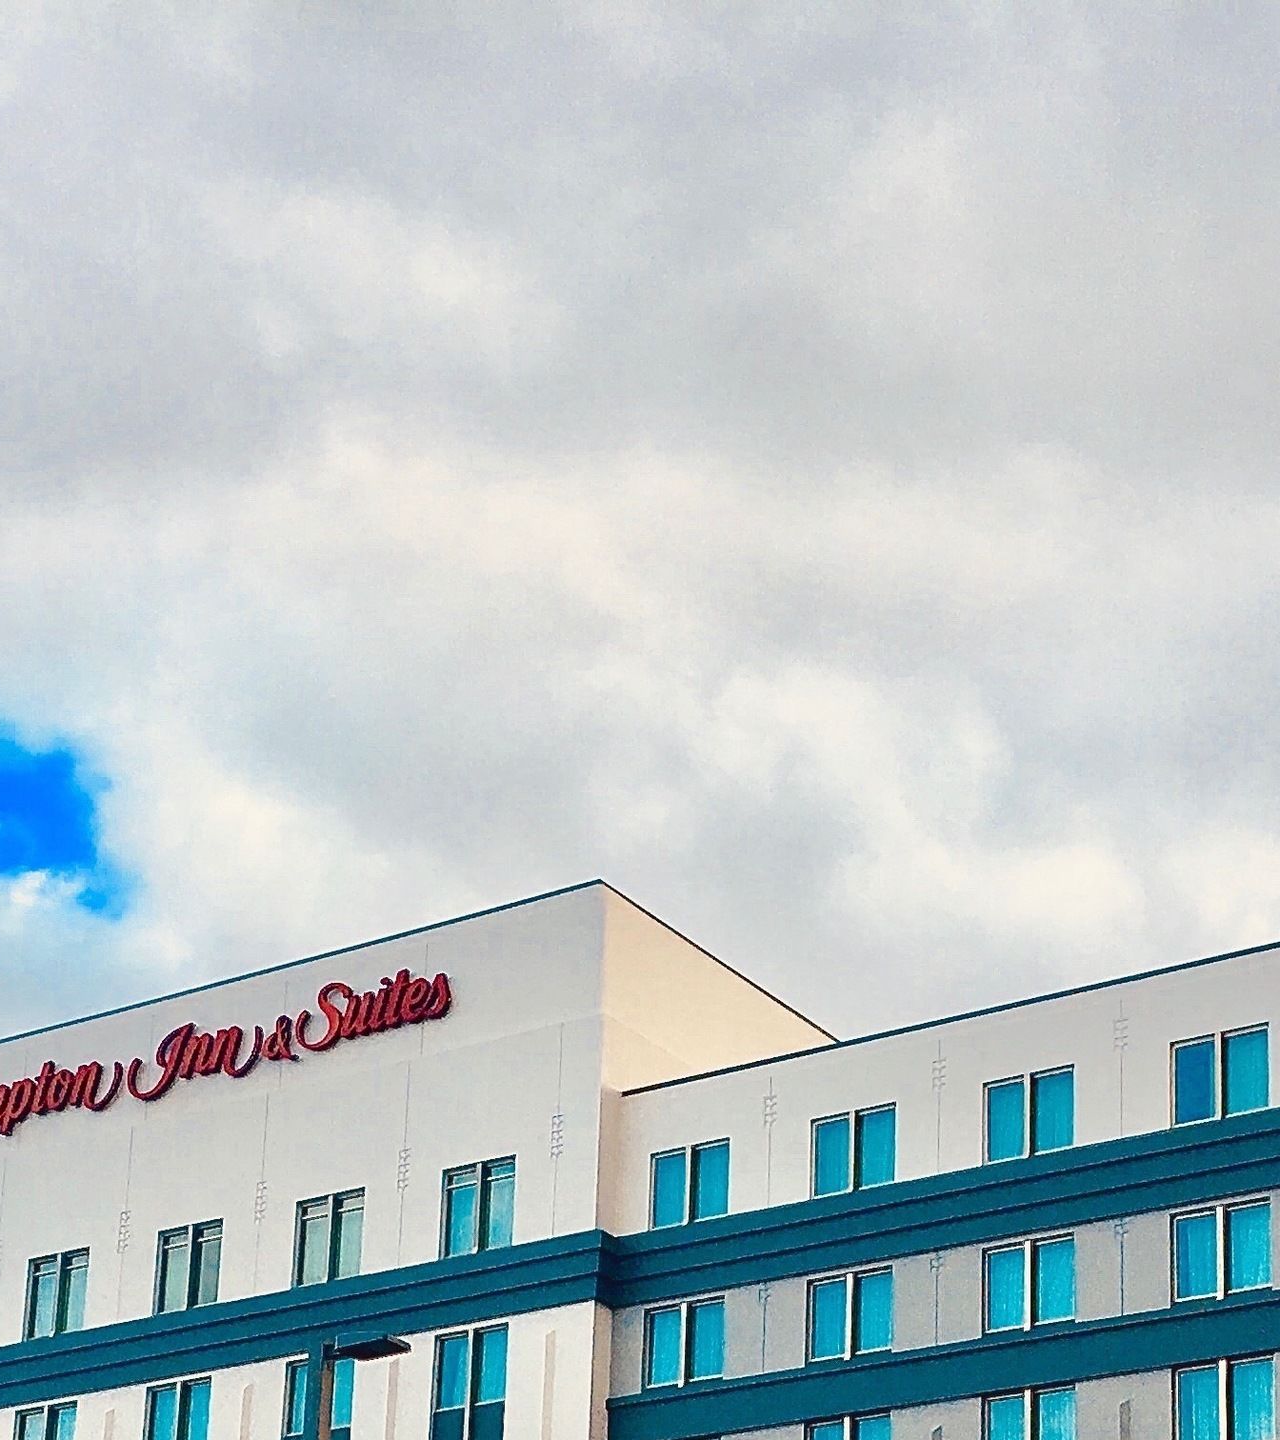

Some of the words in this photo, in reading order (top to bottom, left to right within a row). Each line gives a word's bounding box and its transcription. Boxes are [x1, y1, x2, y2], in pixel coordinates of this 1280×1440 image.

[127, 1022, 263, 1102] Inn
[261, 1015, 299, 1062] &
[295, 968, 453, 1053] Suites
